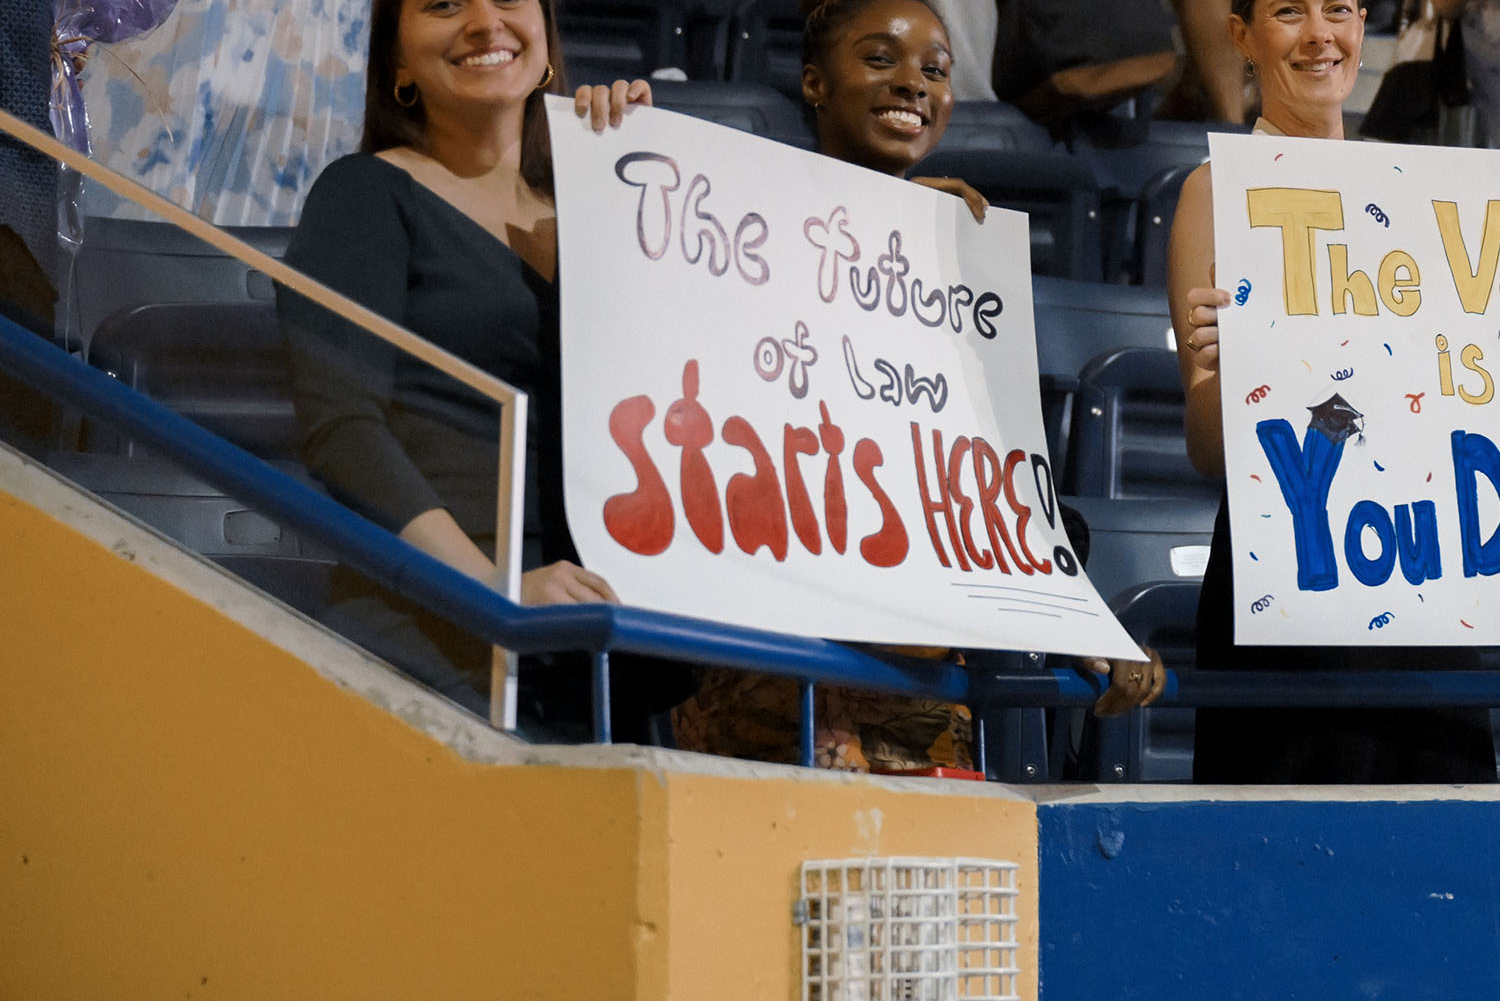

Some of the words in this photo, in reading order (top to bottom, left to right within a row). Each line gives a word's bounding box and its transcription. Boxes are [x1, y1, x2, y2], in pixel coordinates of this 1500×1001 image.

[614, 151, 771, 286] The
[1246, 187, 1423, 317] The
[753, 319, 818, 399] of
[1435, 333, 1495, 405] is
[909, 421, 1079, 577] HERE!
[1255, 417, 1442, 592] You
